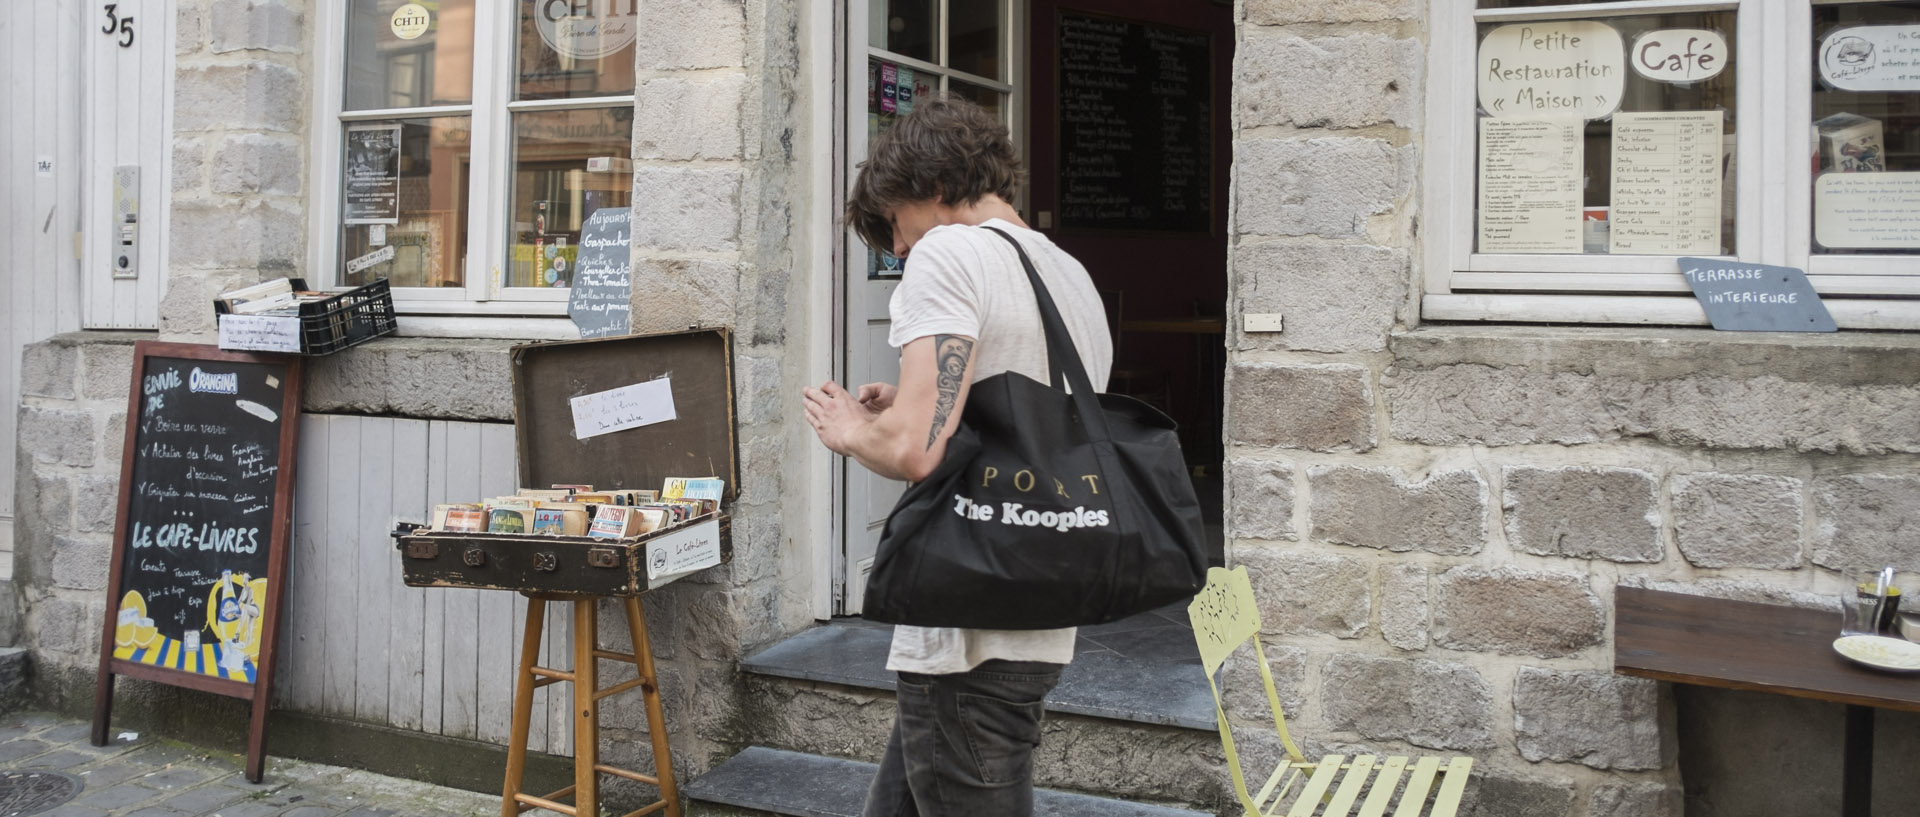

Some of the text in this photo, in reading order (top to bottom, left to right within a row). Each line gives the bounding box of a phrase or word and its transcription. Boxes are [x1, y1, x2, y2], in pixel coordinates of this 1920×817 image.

[102, 4, 134, 48] 35
[1519, 27, 1581, 53] Petite
[1640, 37, 1715, 78] Café
[1488, 58, 1613, 83] Restauration
[1516, 87, 1584, 111] Maison
[584, 230, 631, 250] Gaspacho
[1686, 268, 1763, 283] TERRASSE
[189, 366, 238, 394] ORANGINA
[155, 415, 226, 435] Boire un verre
[152, 441, 224, 461] Acheter des livres
[954, 494, 1110, 533] The Kooples
[132, 521, 152, 548] LE
